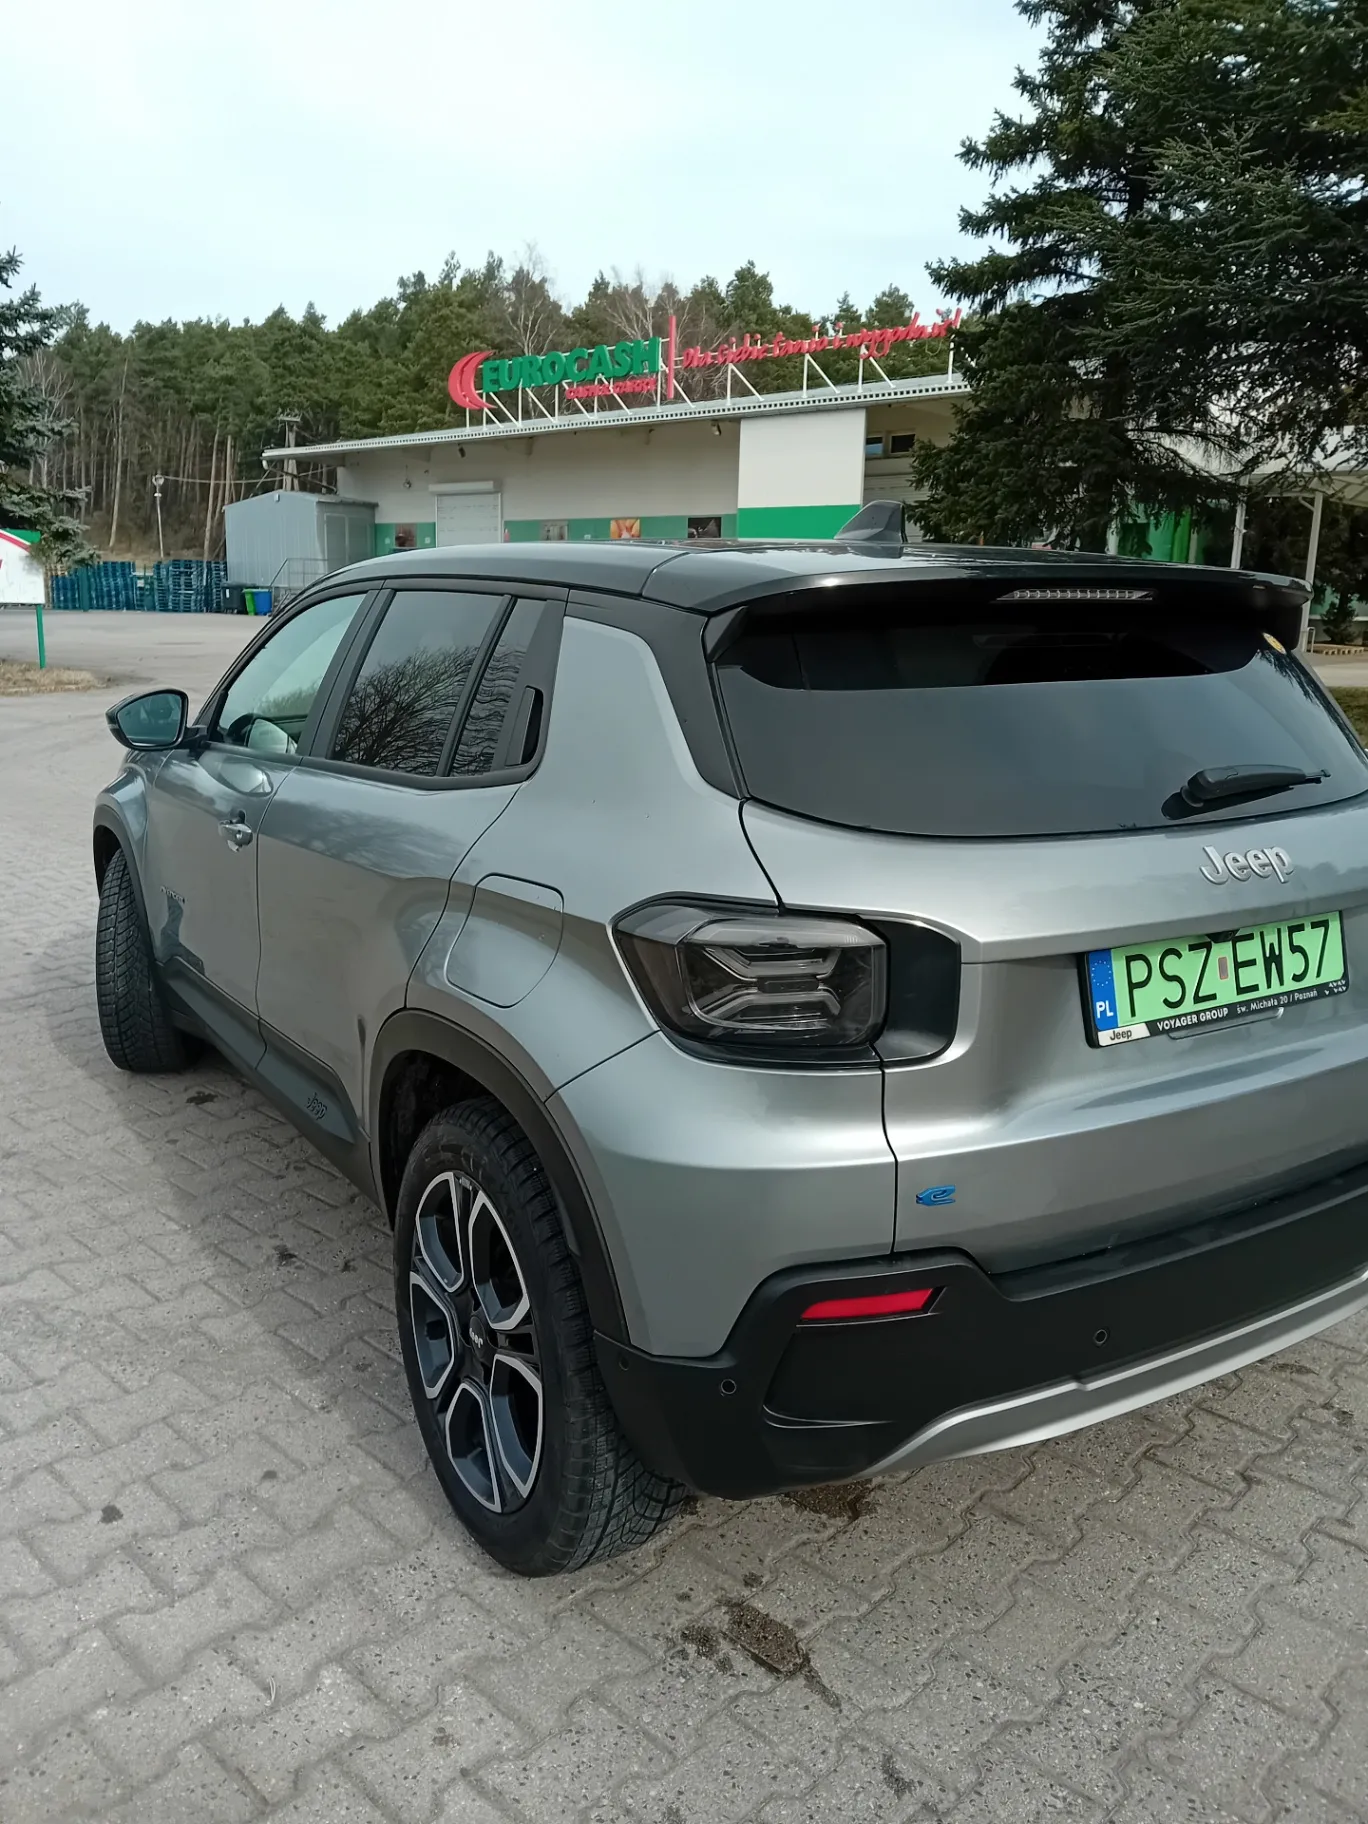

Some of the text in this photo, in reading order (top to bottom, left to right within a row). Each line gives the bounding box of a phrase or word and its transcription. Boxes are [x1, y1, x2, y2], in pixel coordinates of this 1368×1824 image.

[482, 336, 661, 393] EUROCASH
[1200, 845, 1294, 885] Jeep
[1124, 919, 1331, 1018] PSZ EW57
[1096, 1001, 1114, 1019] PL
[1157, 1007, 1229, 1032] VOYAGER GROUP
[1109, 1029, 1132, 1041] Jeep
